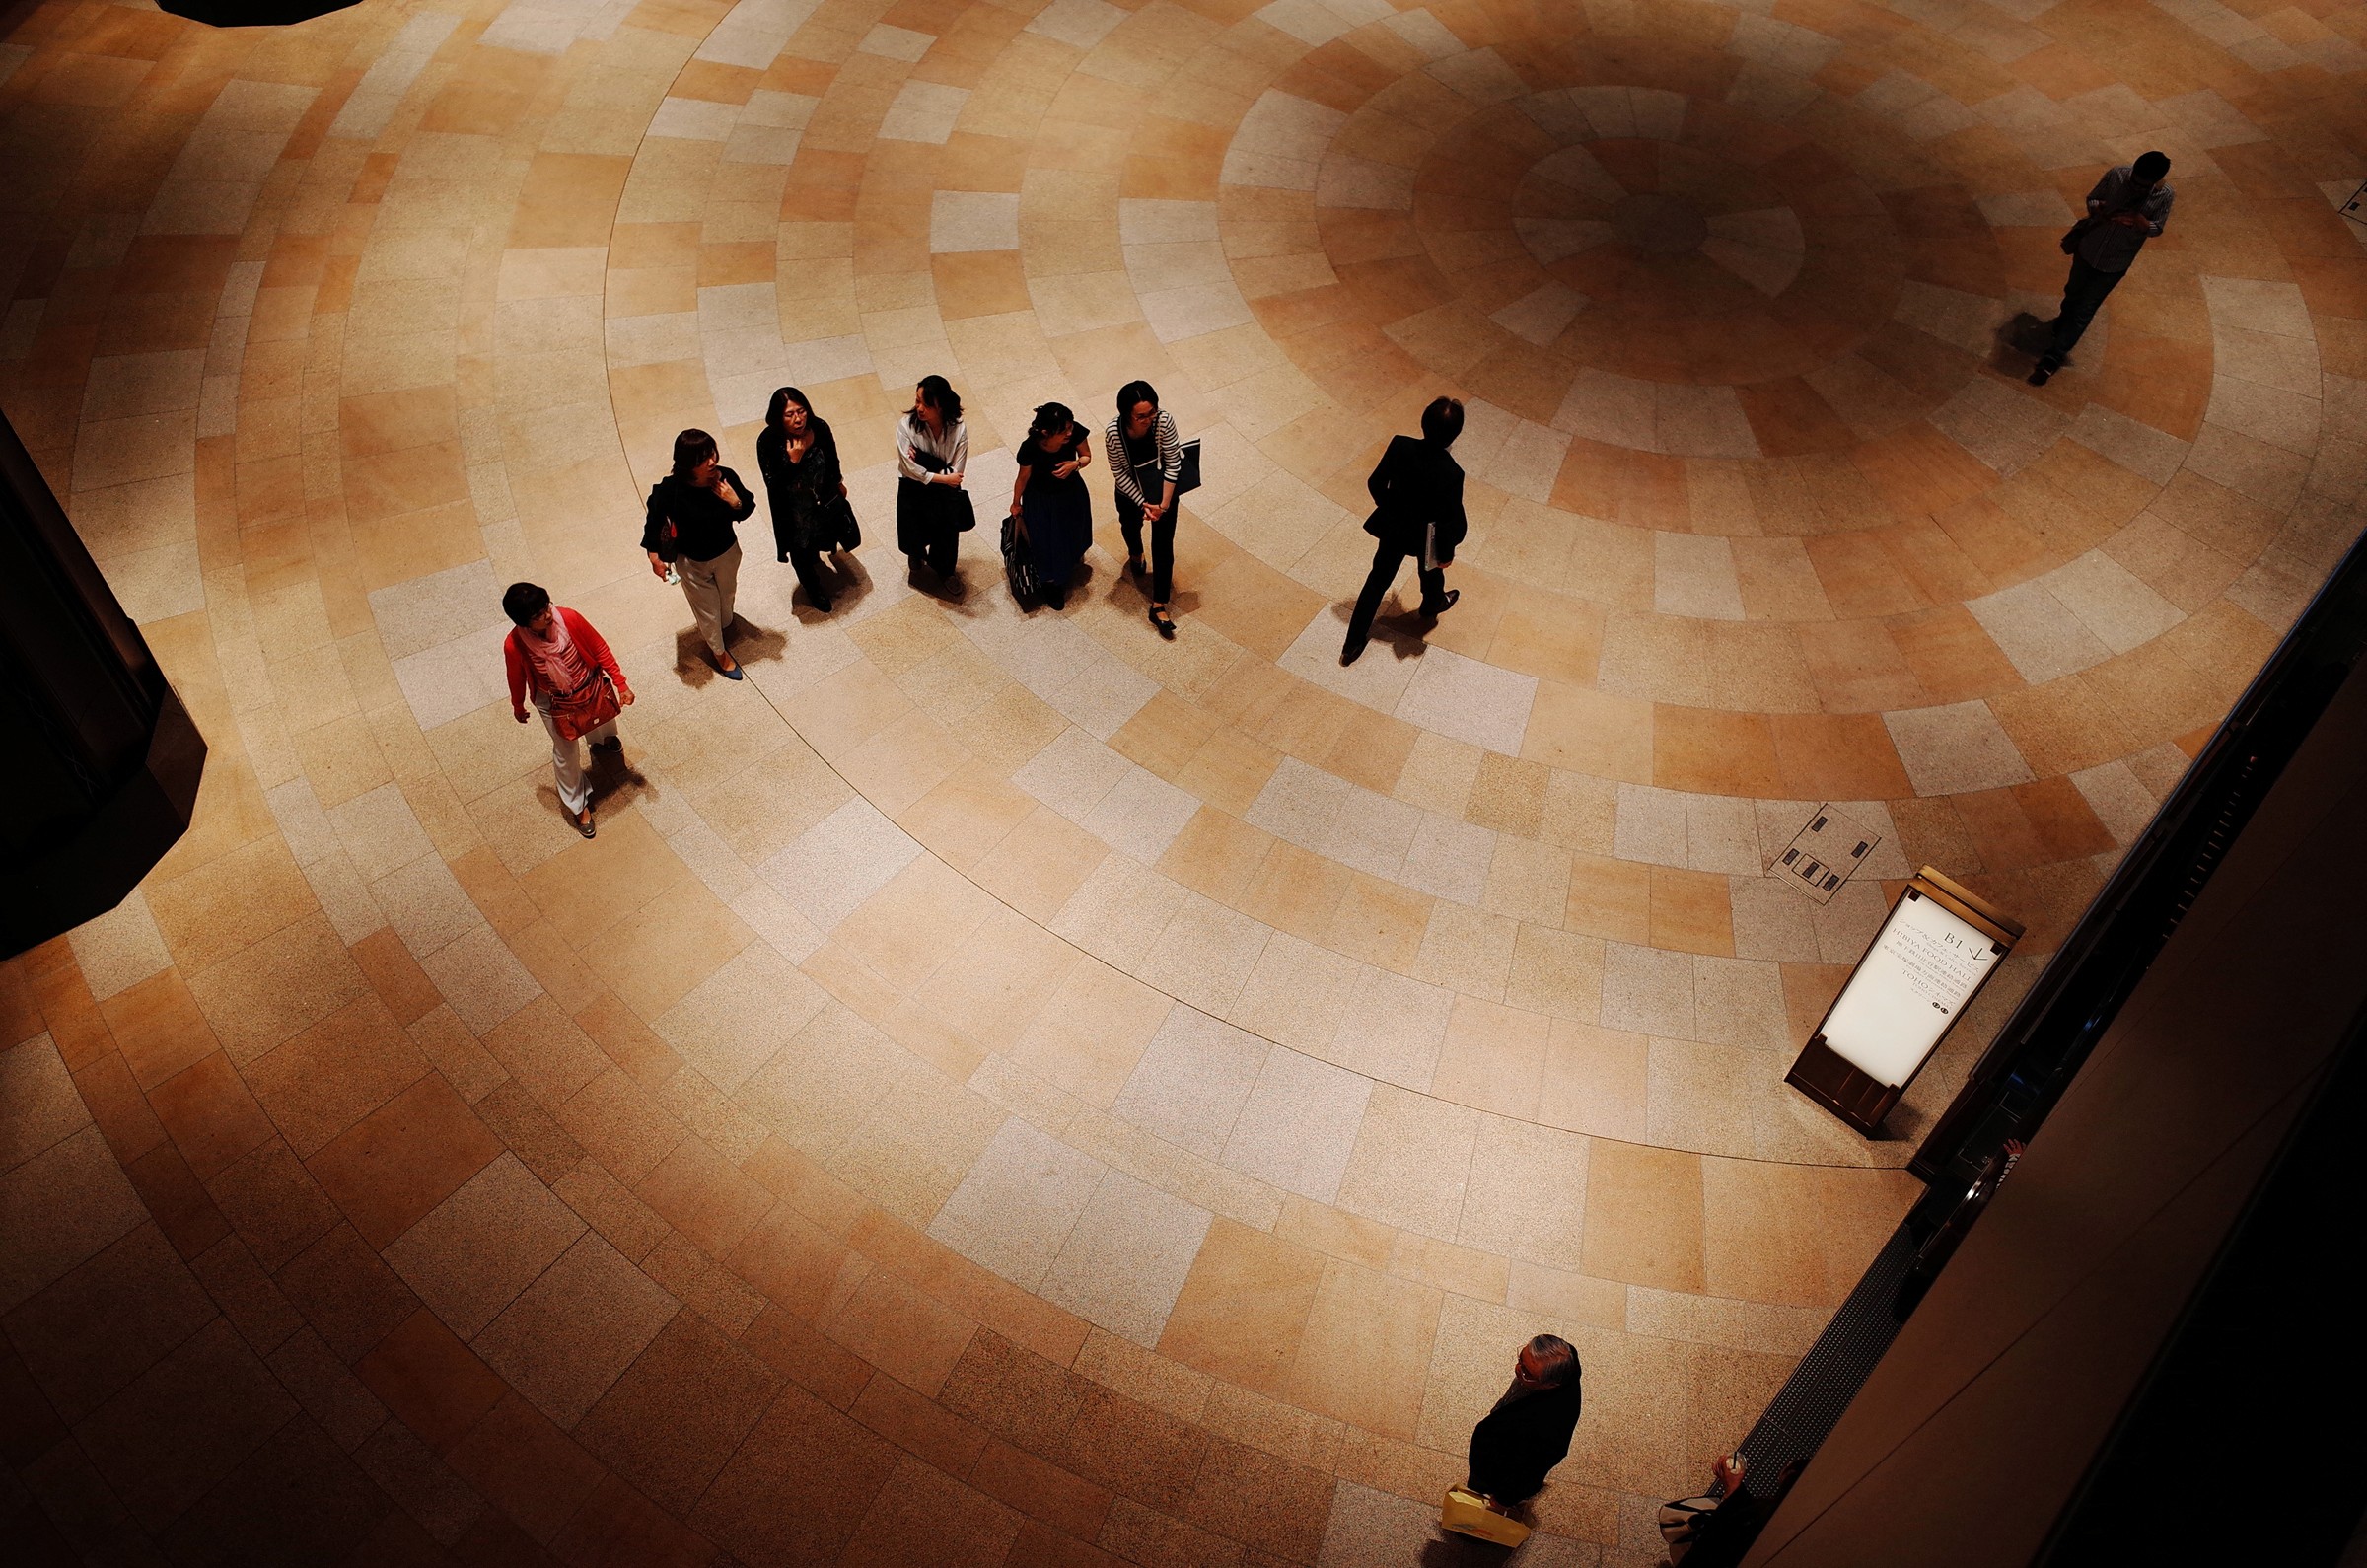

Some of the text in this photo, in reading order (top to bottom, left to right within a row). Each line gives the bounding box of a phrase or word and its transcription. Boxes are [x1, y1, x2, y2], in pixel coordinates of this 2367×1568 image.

[1892, 928, 1921, 949] HIBIYA
[1922, 947, 1948, 965] FOOD
[1948, 964, 1973, 983] HALL
[1944, 932, 1963, 948] B1
